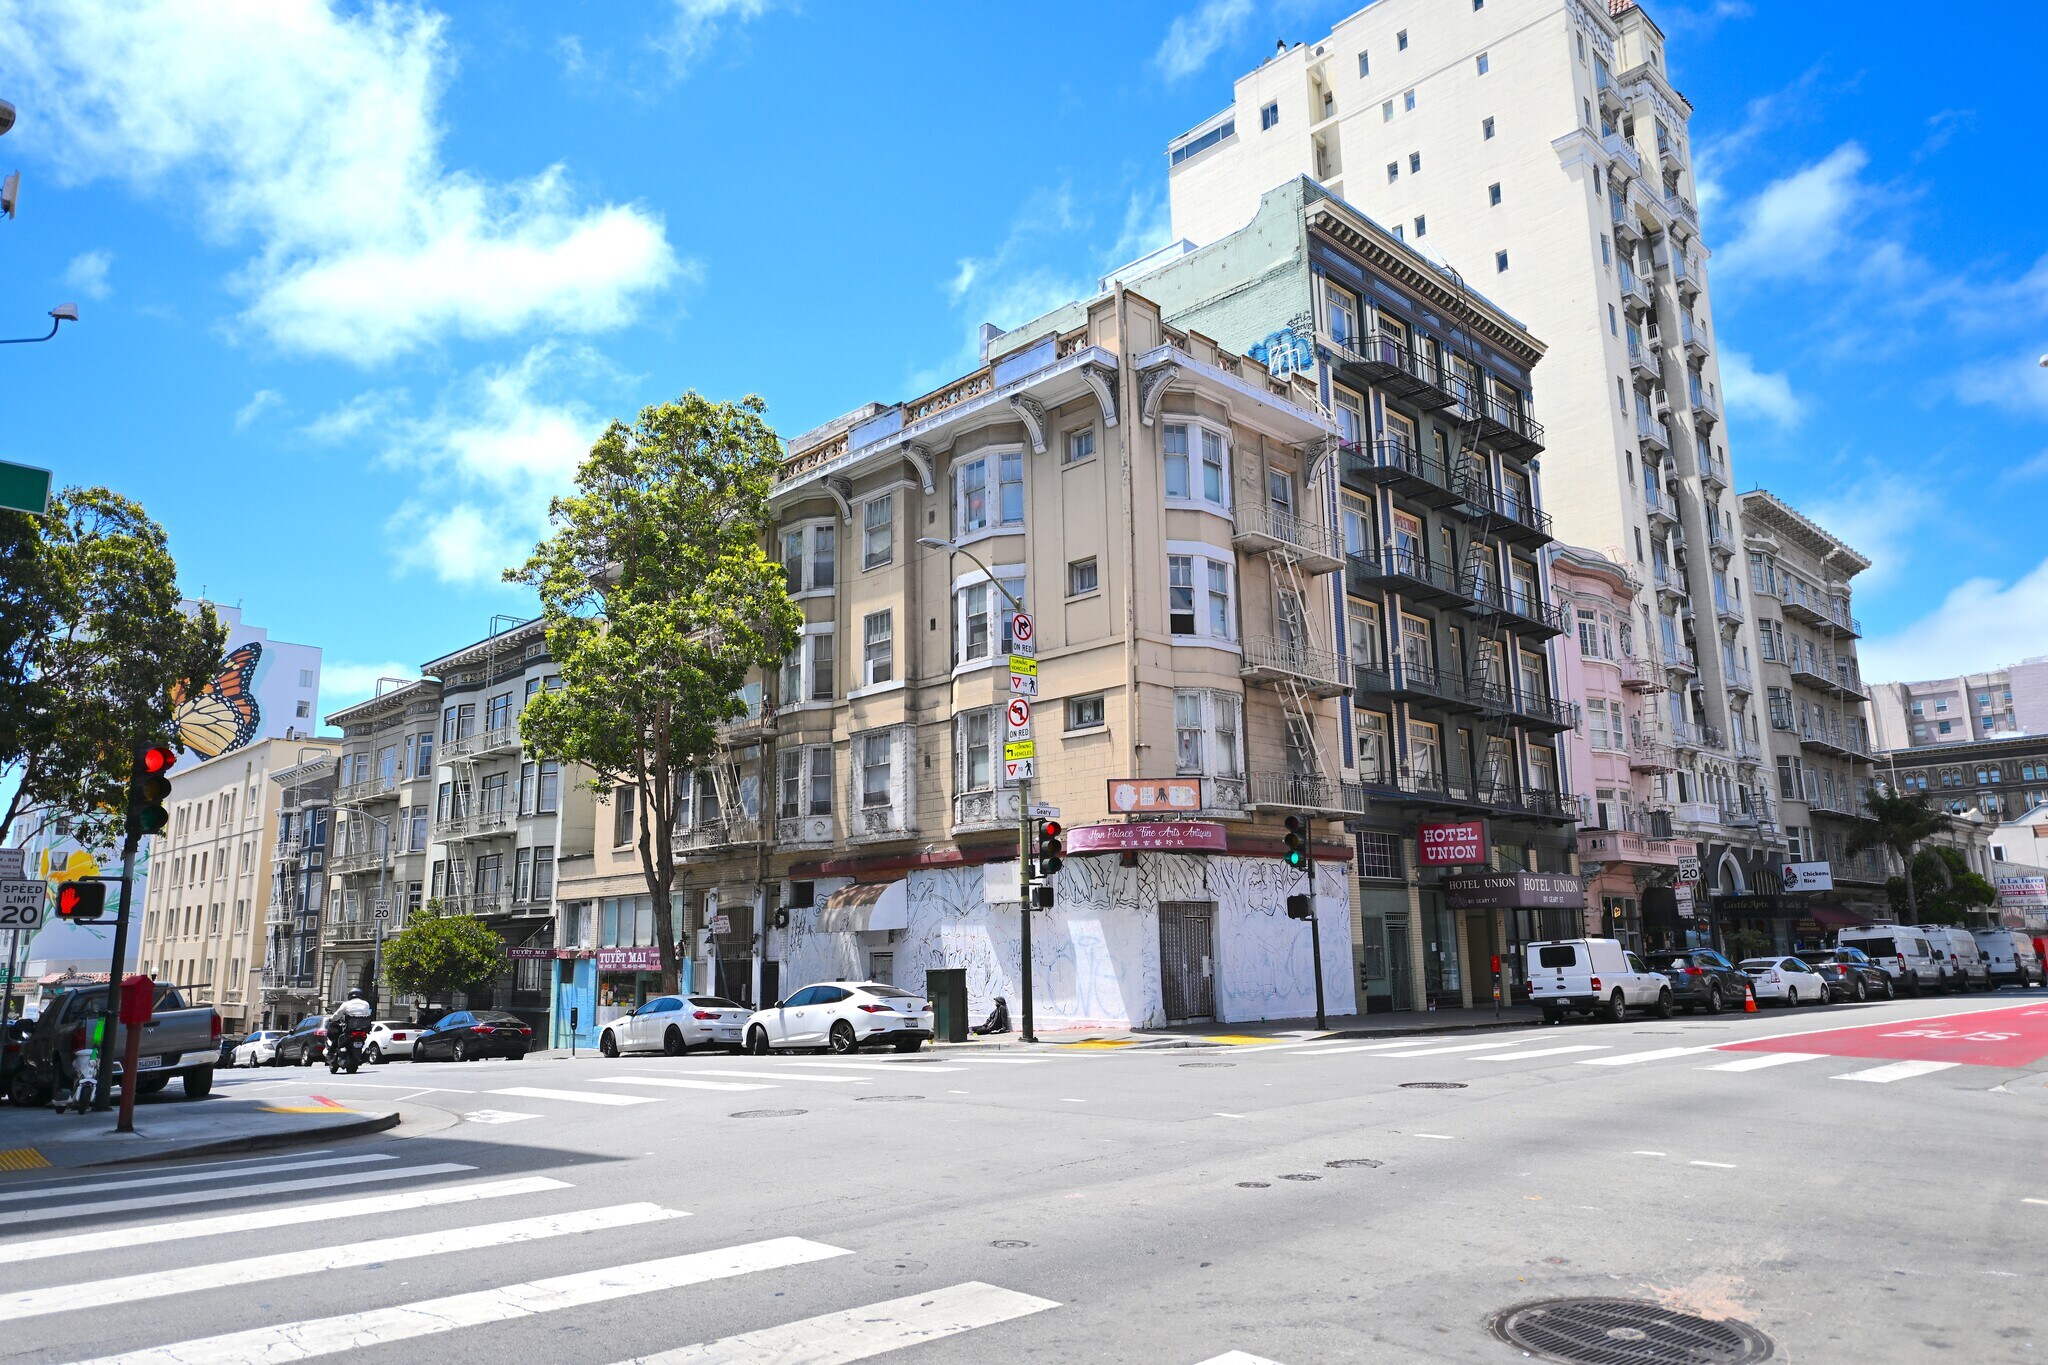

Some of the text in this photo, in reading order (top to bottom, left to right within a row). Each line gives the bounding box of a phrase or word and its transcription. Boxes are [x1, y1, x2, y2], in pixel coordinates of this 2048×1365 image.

[1014, 642, 1032, 652] ON RED
[1018, 728, 1028, 736] RED
[1088, 826, 1212, 840] Han Palace Fine Arts Antiques
[1424, 828, 1478, 843] HOTEL
[1426, 845, 1476, 860] UNION
[1682, 869, 1697, 878] 20
[1450, 878, 1516, 890] HOTEL UNION
[1524, 878, 1578, 892] HOTEL UNION
[3, 886, 42, 894] SPEED
[6, 896, 37, 904] LIMIT
[1723, 900, 1747, 908] Castle
[0, 906, 38, 924] 20
[629, 952, 646, 963] MAI
[1877, 1030, 2022, 1041] BUS
